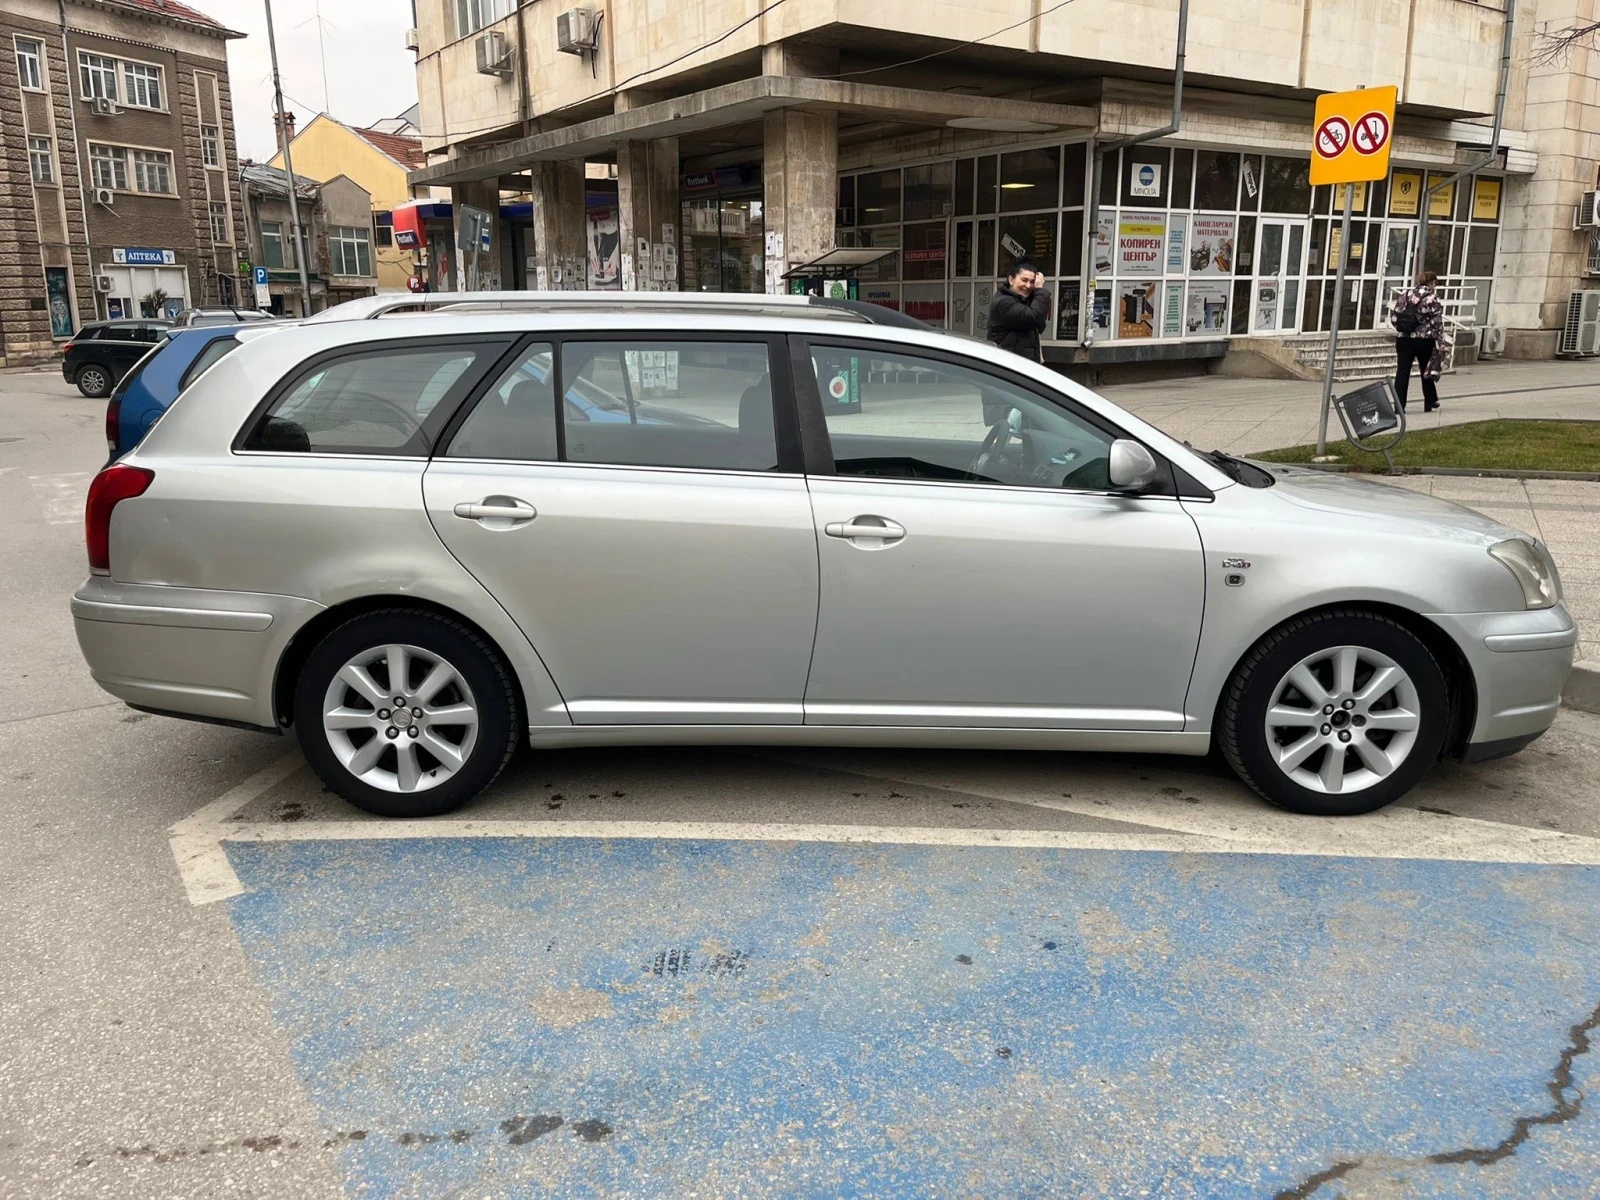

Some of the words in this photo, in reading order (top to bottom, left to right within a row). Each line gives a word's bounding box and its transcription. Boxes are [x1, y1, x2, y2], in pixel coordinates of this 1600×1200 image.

[687, 175, 709, 186] Postbank
[1133, 187, 1156, 196] MINOLTA
[1193, 220, 1233, 229] КАНЦЕЛАРСКИ
[1120, 238, 1161, 249] КОПИРЕН
[128, 252, 162, 261] АПТЕКА
[1123, 251, 1157, 262] ЦЕНТЪР
[257, 269, 265, 282] P
